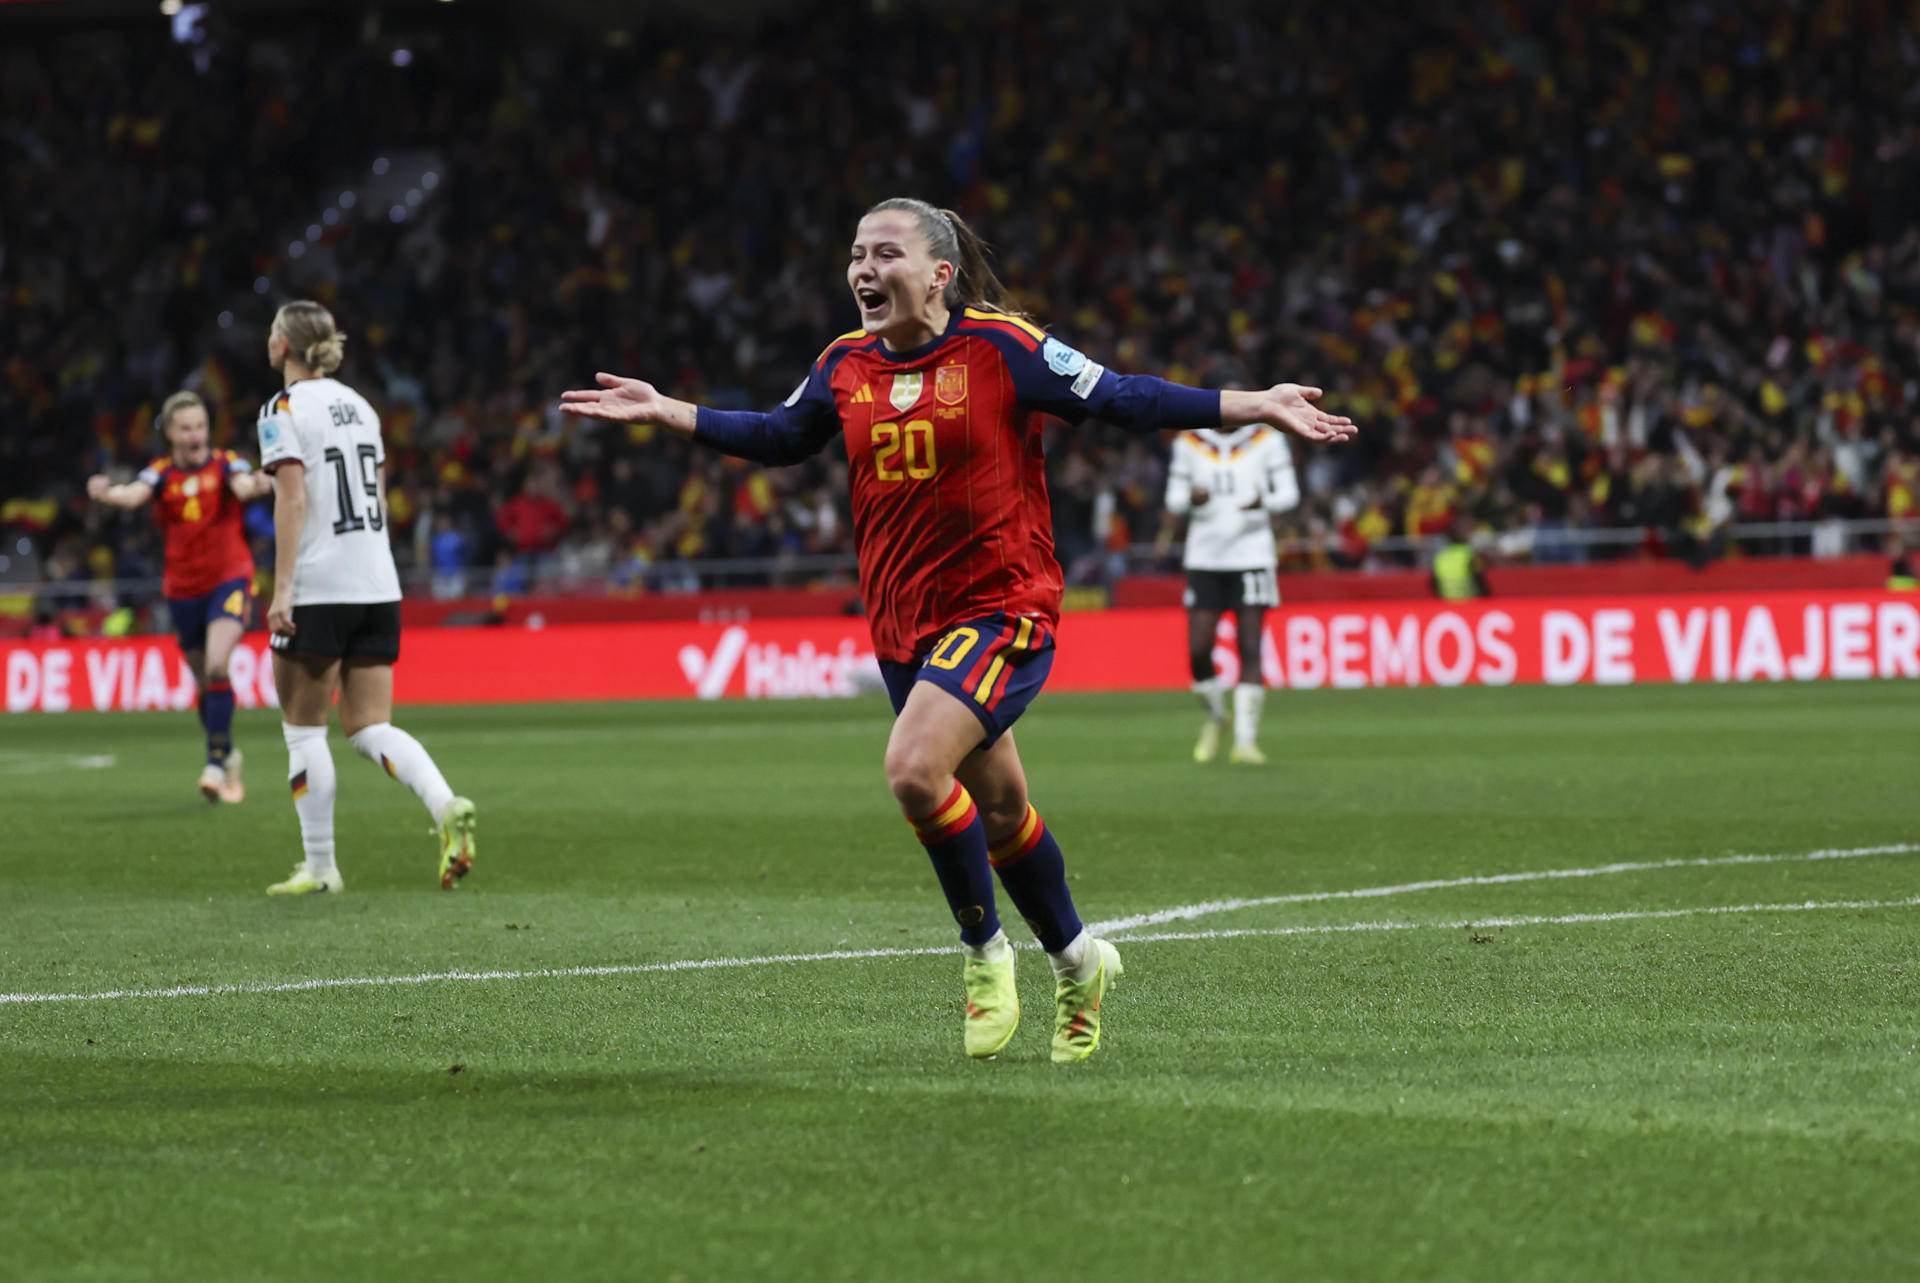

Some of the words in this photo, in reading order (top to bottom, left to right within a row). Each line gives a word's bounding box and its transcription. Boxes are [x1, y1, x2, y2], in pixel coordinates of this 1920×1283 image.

[329, 399, 364, 427] BÜHL
[871, 420, 937, 481] 20
[325, 444, 383, 535] 19
[224, 590, 244, 616] 4
[923, 627, 980, 669] 0
[1542, 609, 1635, 685] DE
[1656, 602, 1920, 684] VIAJER
[7, 649, 72, 713] DE
